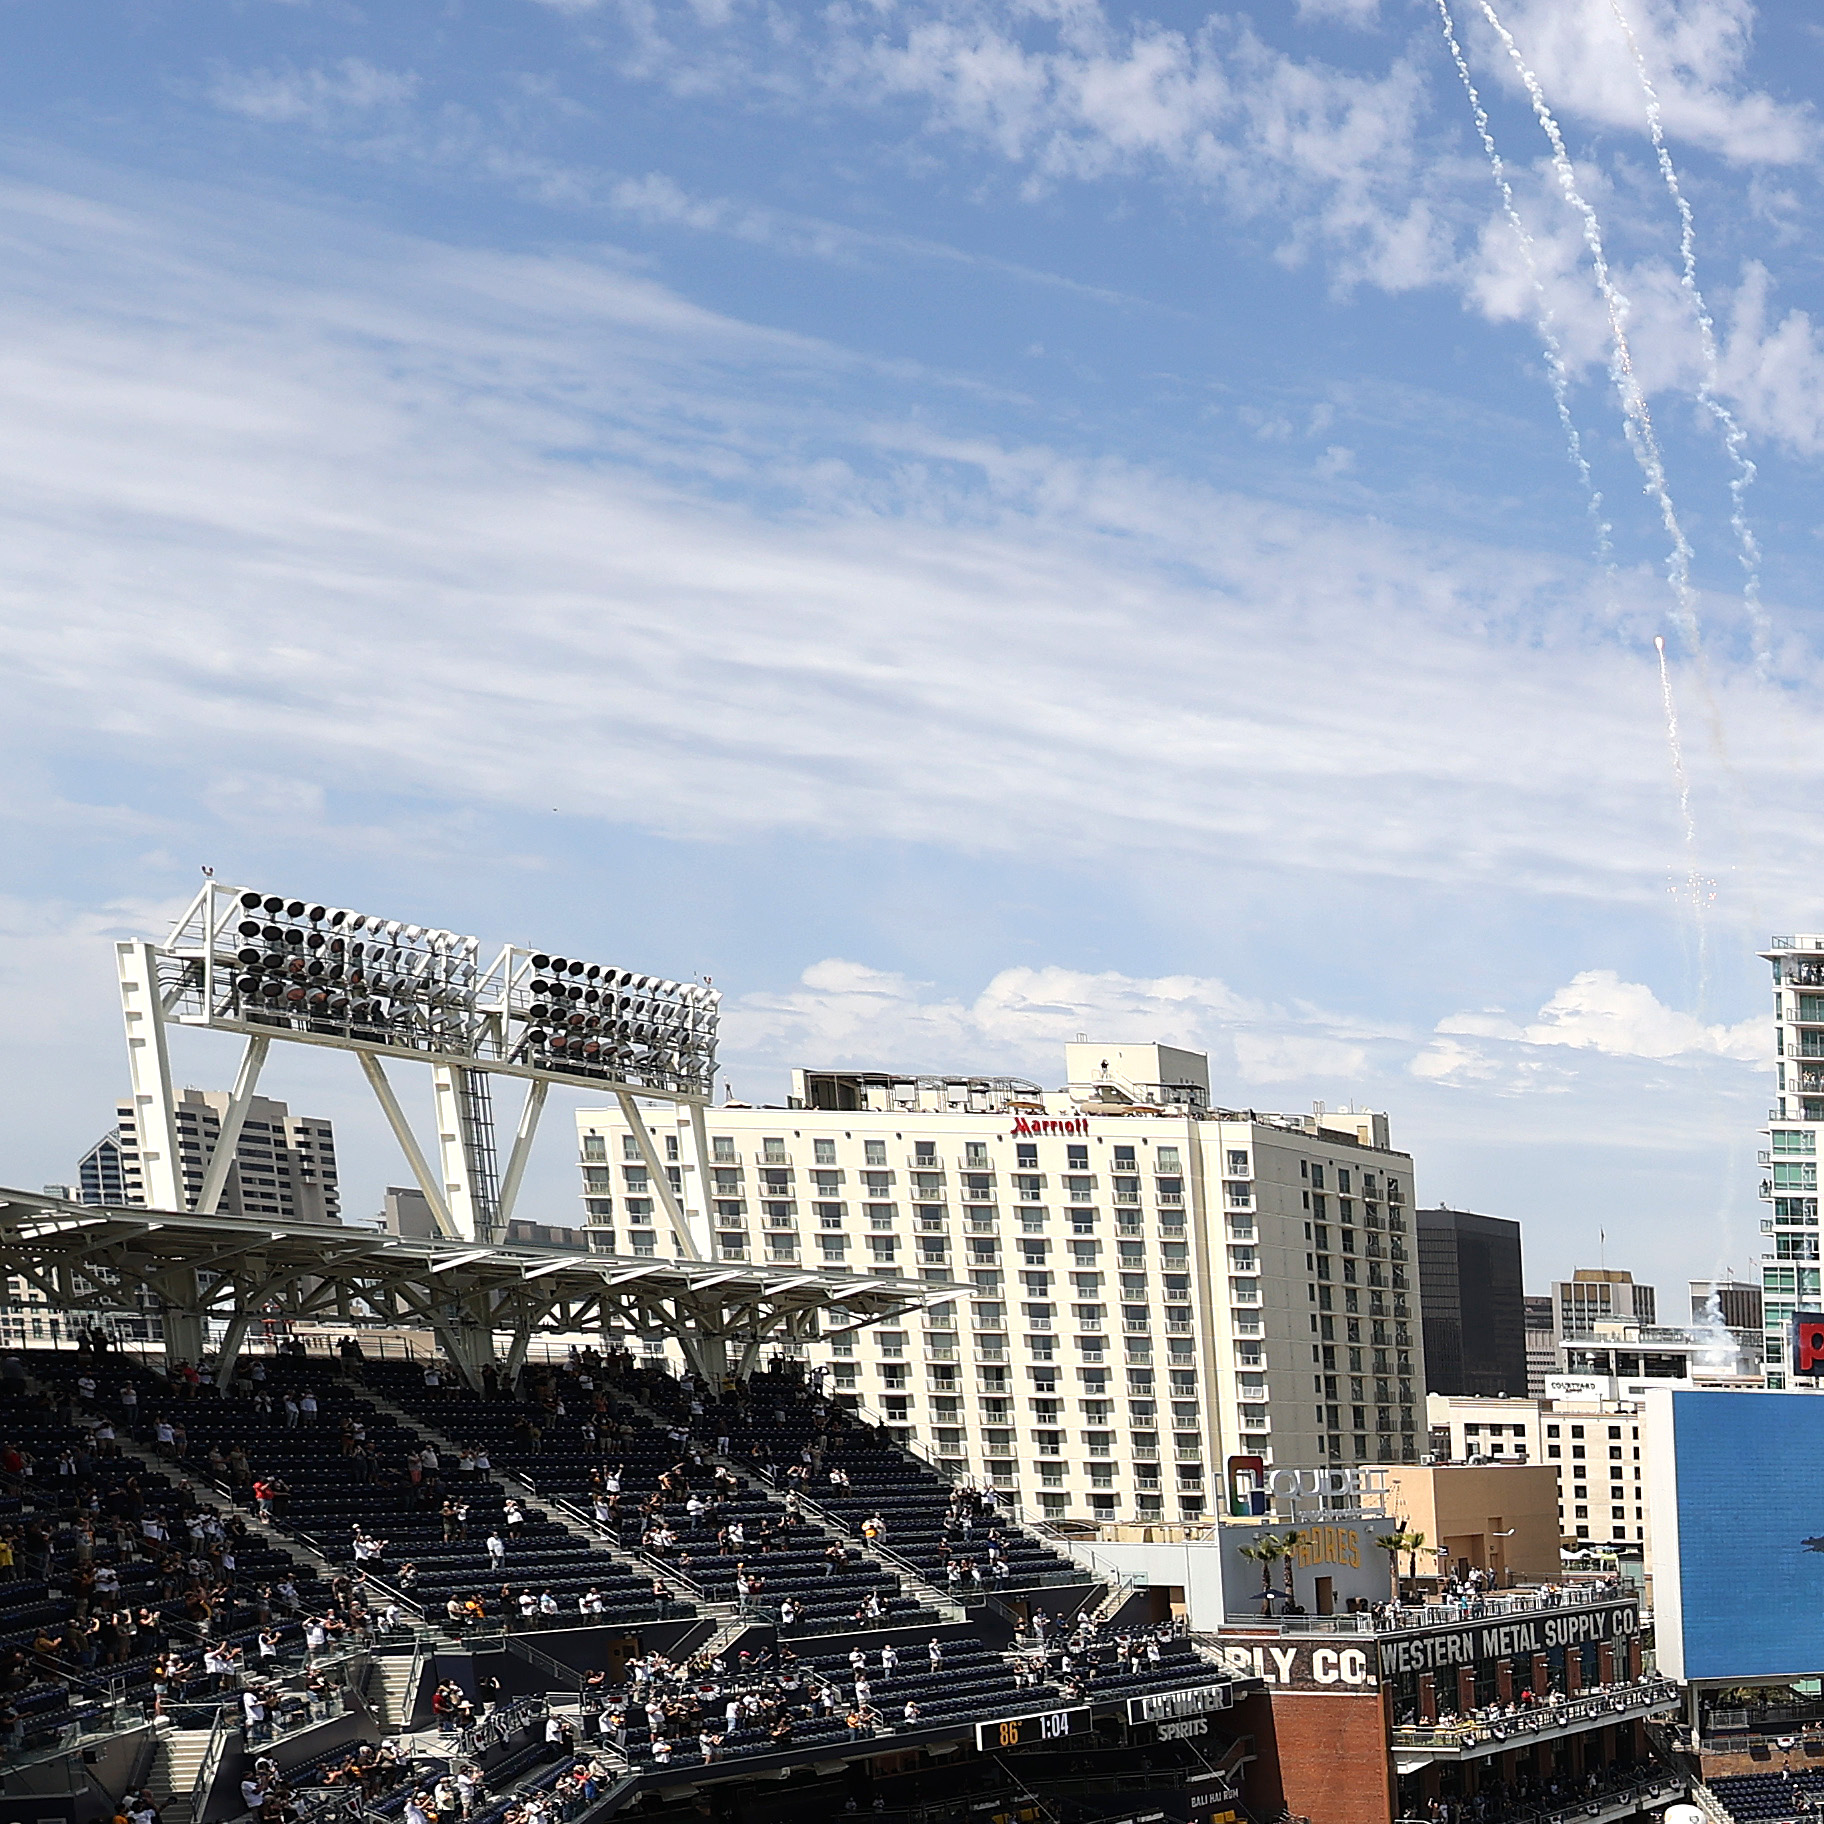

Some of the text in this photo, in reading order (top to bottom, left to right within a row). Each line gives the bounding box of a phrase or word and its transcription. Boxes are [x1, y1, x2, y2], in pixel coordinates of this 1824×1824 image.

[1010, 1117, 1089, 1135] Marriott
[1380, 1631, 1475, 1676] WESTERN
[1482, 1622, 1541, 1659] METAL
[1544, 1608, 1606, 1649] SUPPLY
[1040, 1712, 1069, 1739] 1:04
[1158, 1717, 1208, 1742] SPIRITS
[1191, 1795, 1208, 1808] BALI
[1210, 1791, 1222, 1804] HAI
